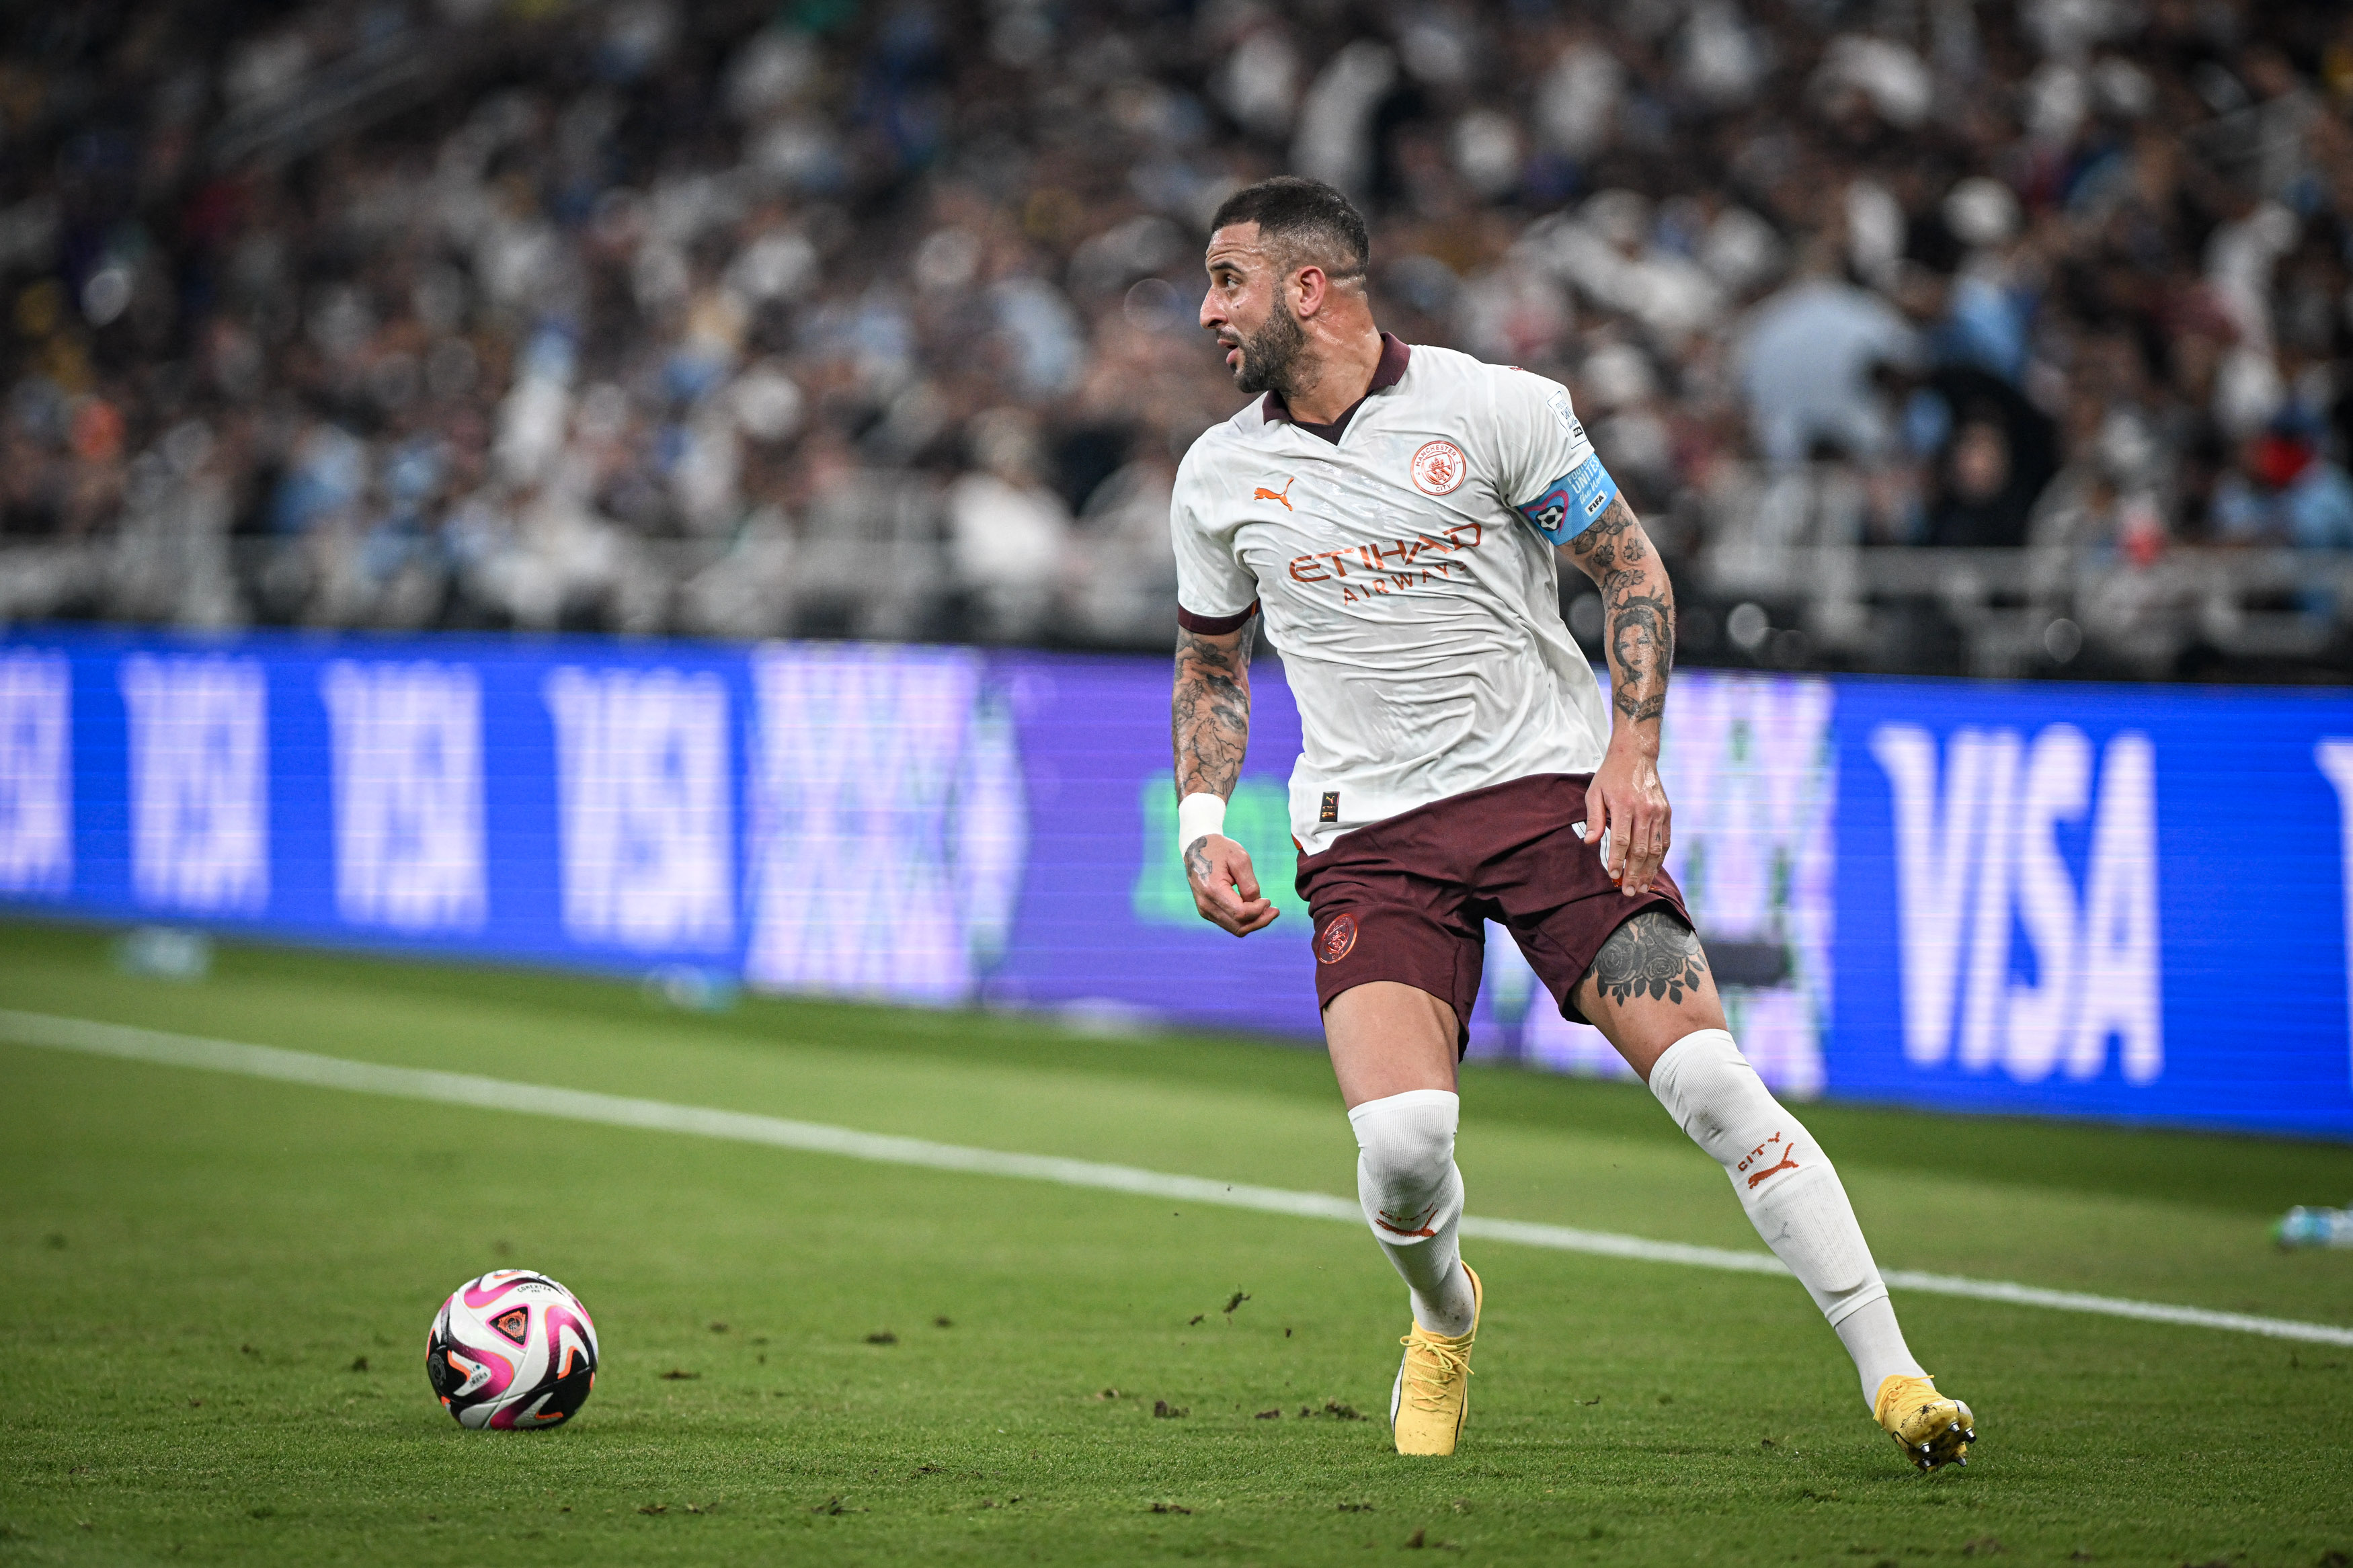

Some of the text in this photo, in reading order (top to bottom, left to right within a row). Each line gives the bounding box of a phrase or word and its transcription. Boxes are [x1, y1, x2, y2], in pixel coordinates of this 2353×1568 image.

[1416, 445, 1457, 467] MANCHESTER
[1571, 456, 1599, 494] UNITES
[1435, 483, 1451, 492] CITY
[1588, 495, 1604, 513] FIFA
[1289, 523, 1482, 583] ETIHAD
[1870, 722, 2164, 1085] VISA
[1737, 1131, 1780, 1171] CITY
